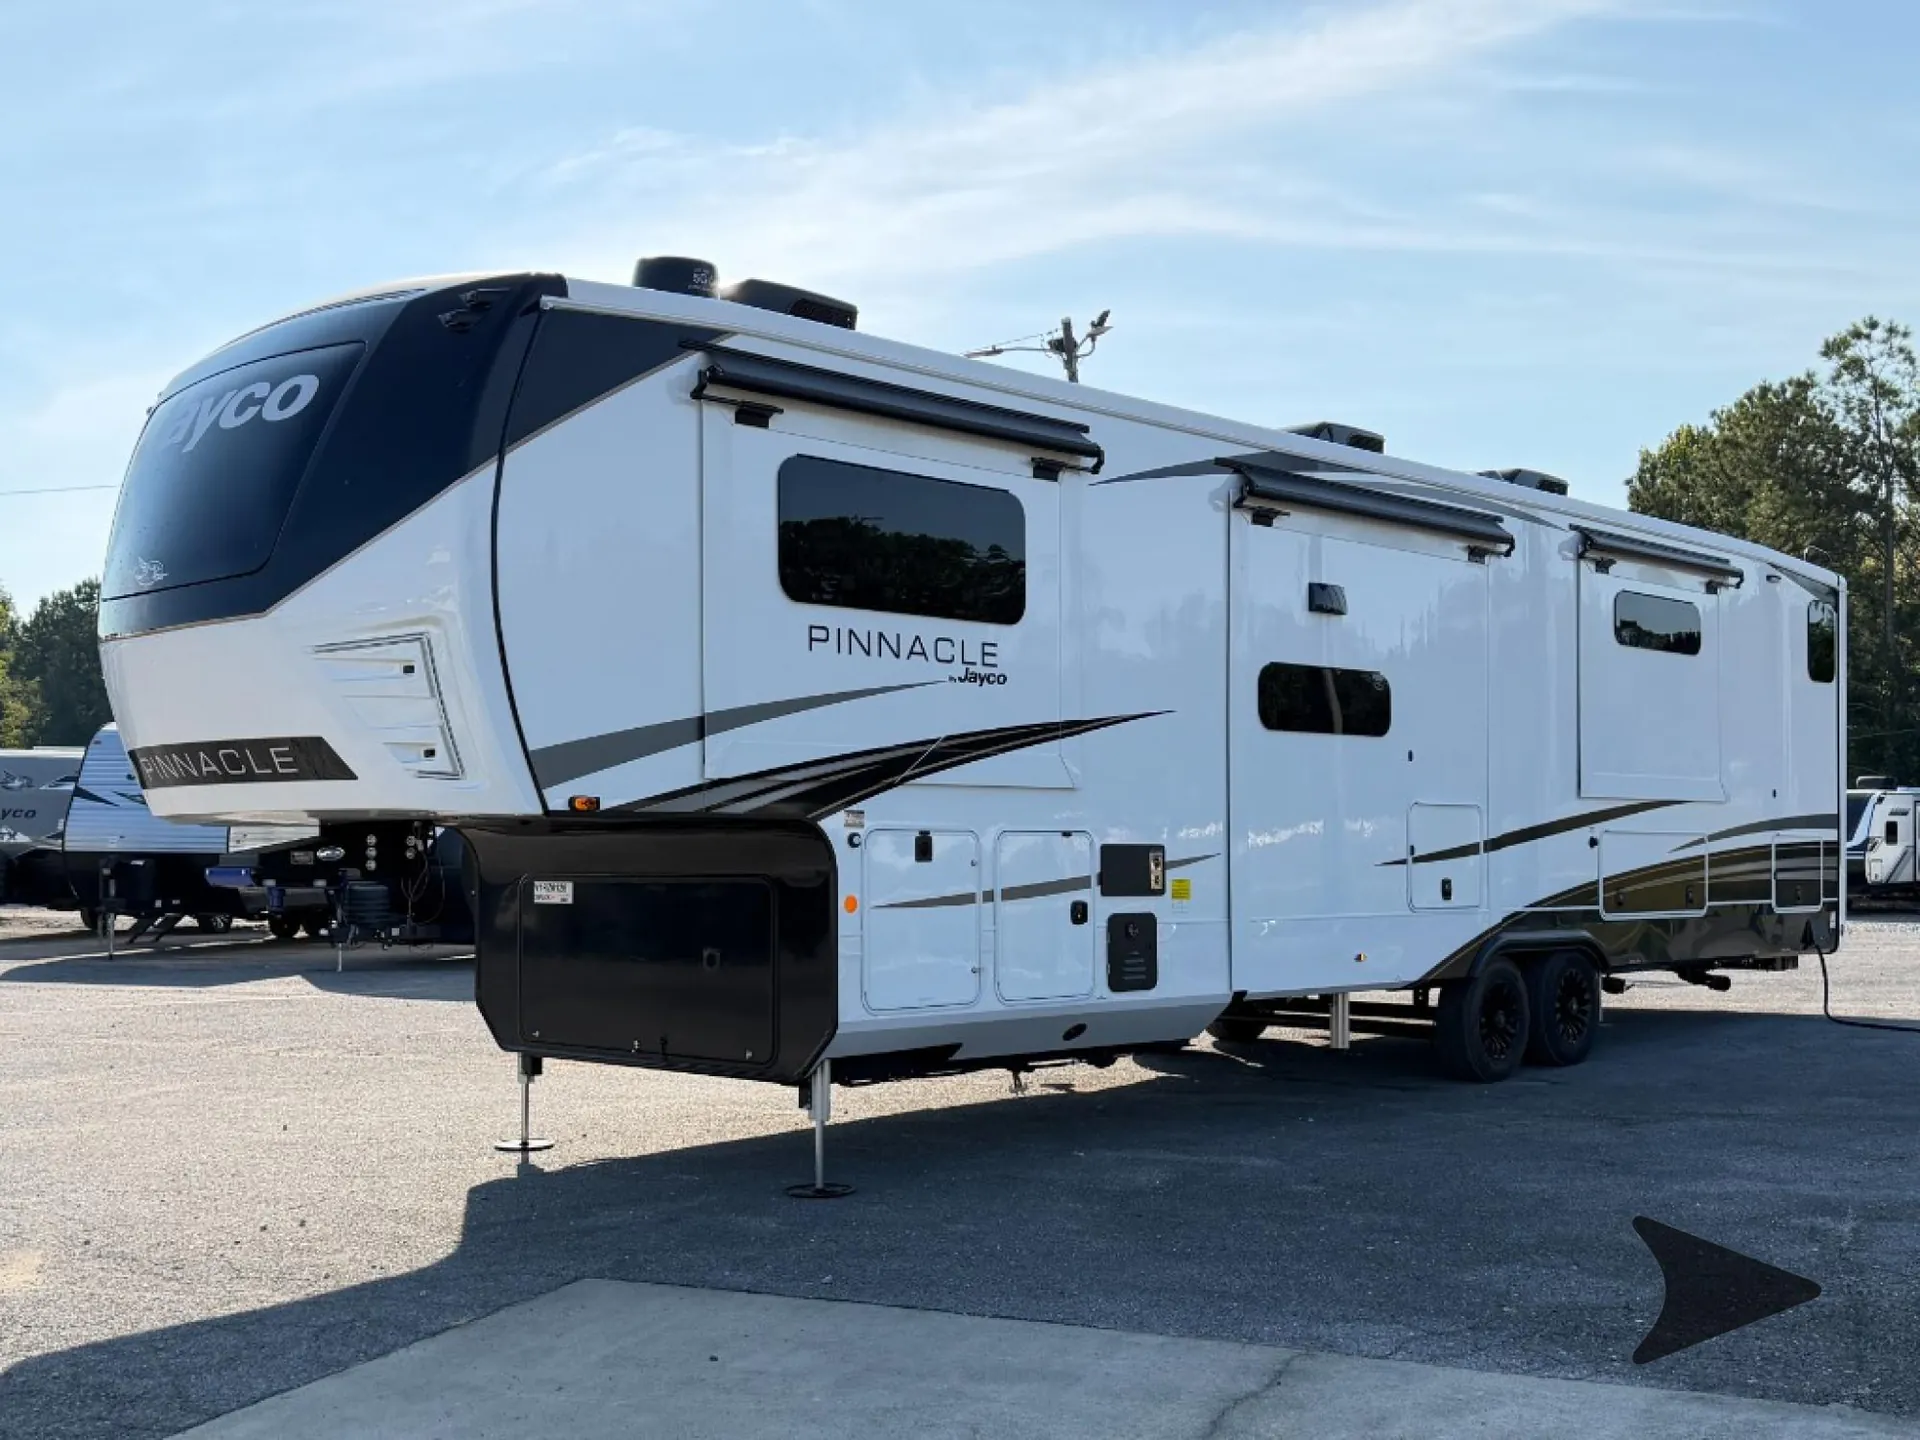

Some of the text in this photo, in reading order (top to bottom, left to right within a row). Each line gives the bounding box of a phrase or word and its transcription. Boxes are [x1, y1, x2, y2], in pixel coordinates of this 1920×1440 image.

[163, 374, 320, 453] ayco
[808, 624, 998, 668] PINNACLE
[958, 667, 1007, 687] Jayco
[138, 746, 299, 782] PINNACLE
